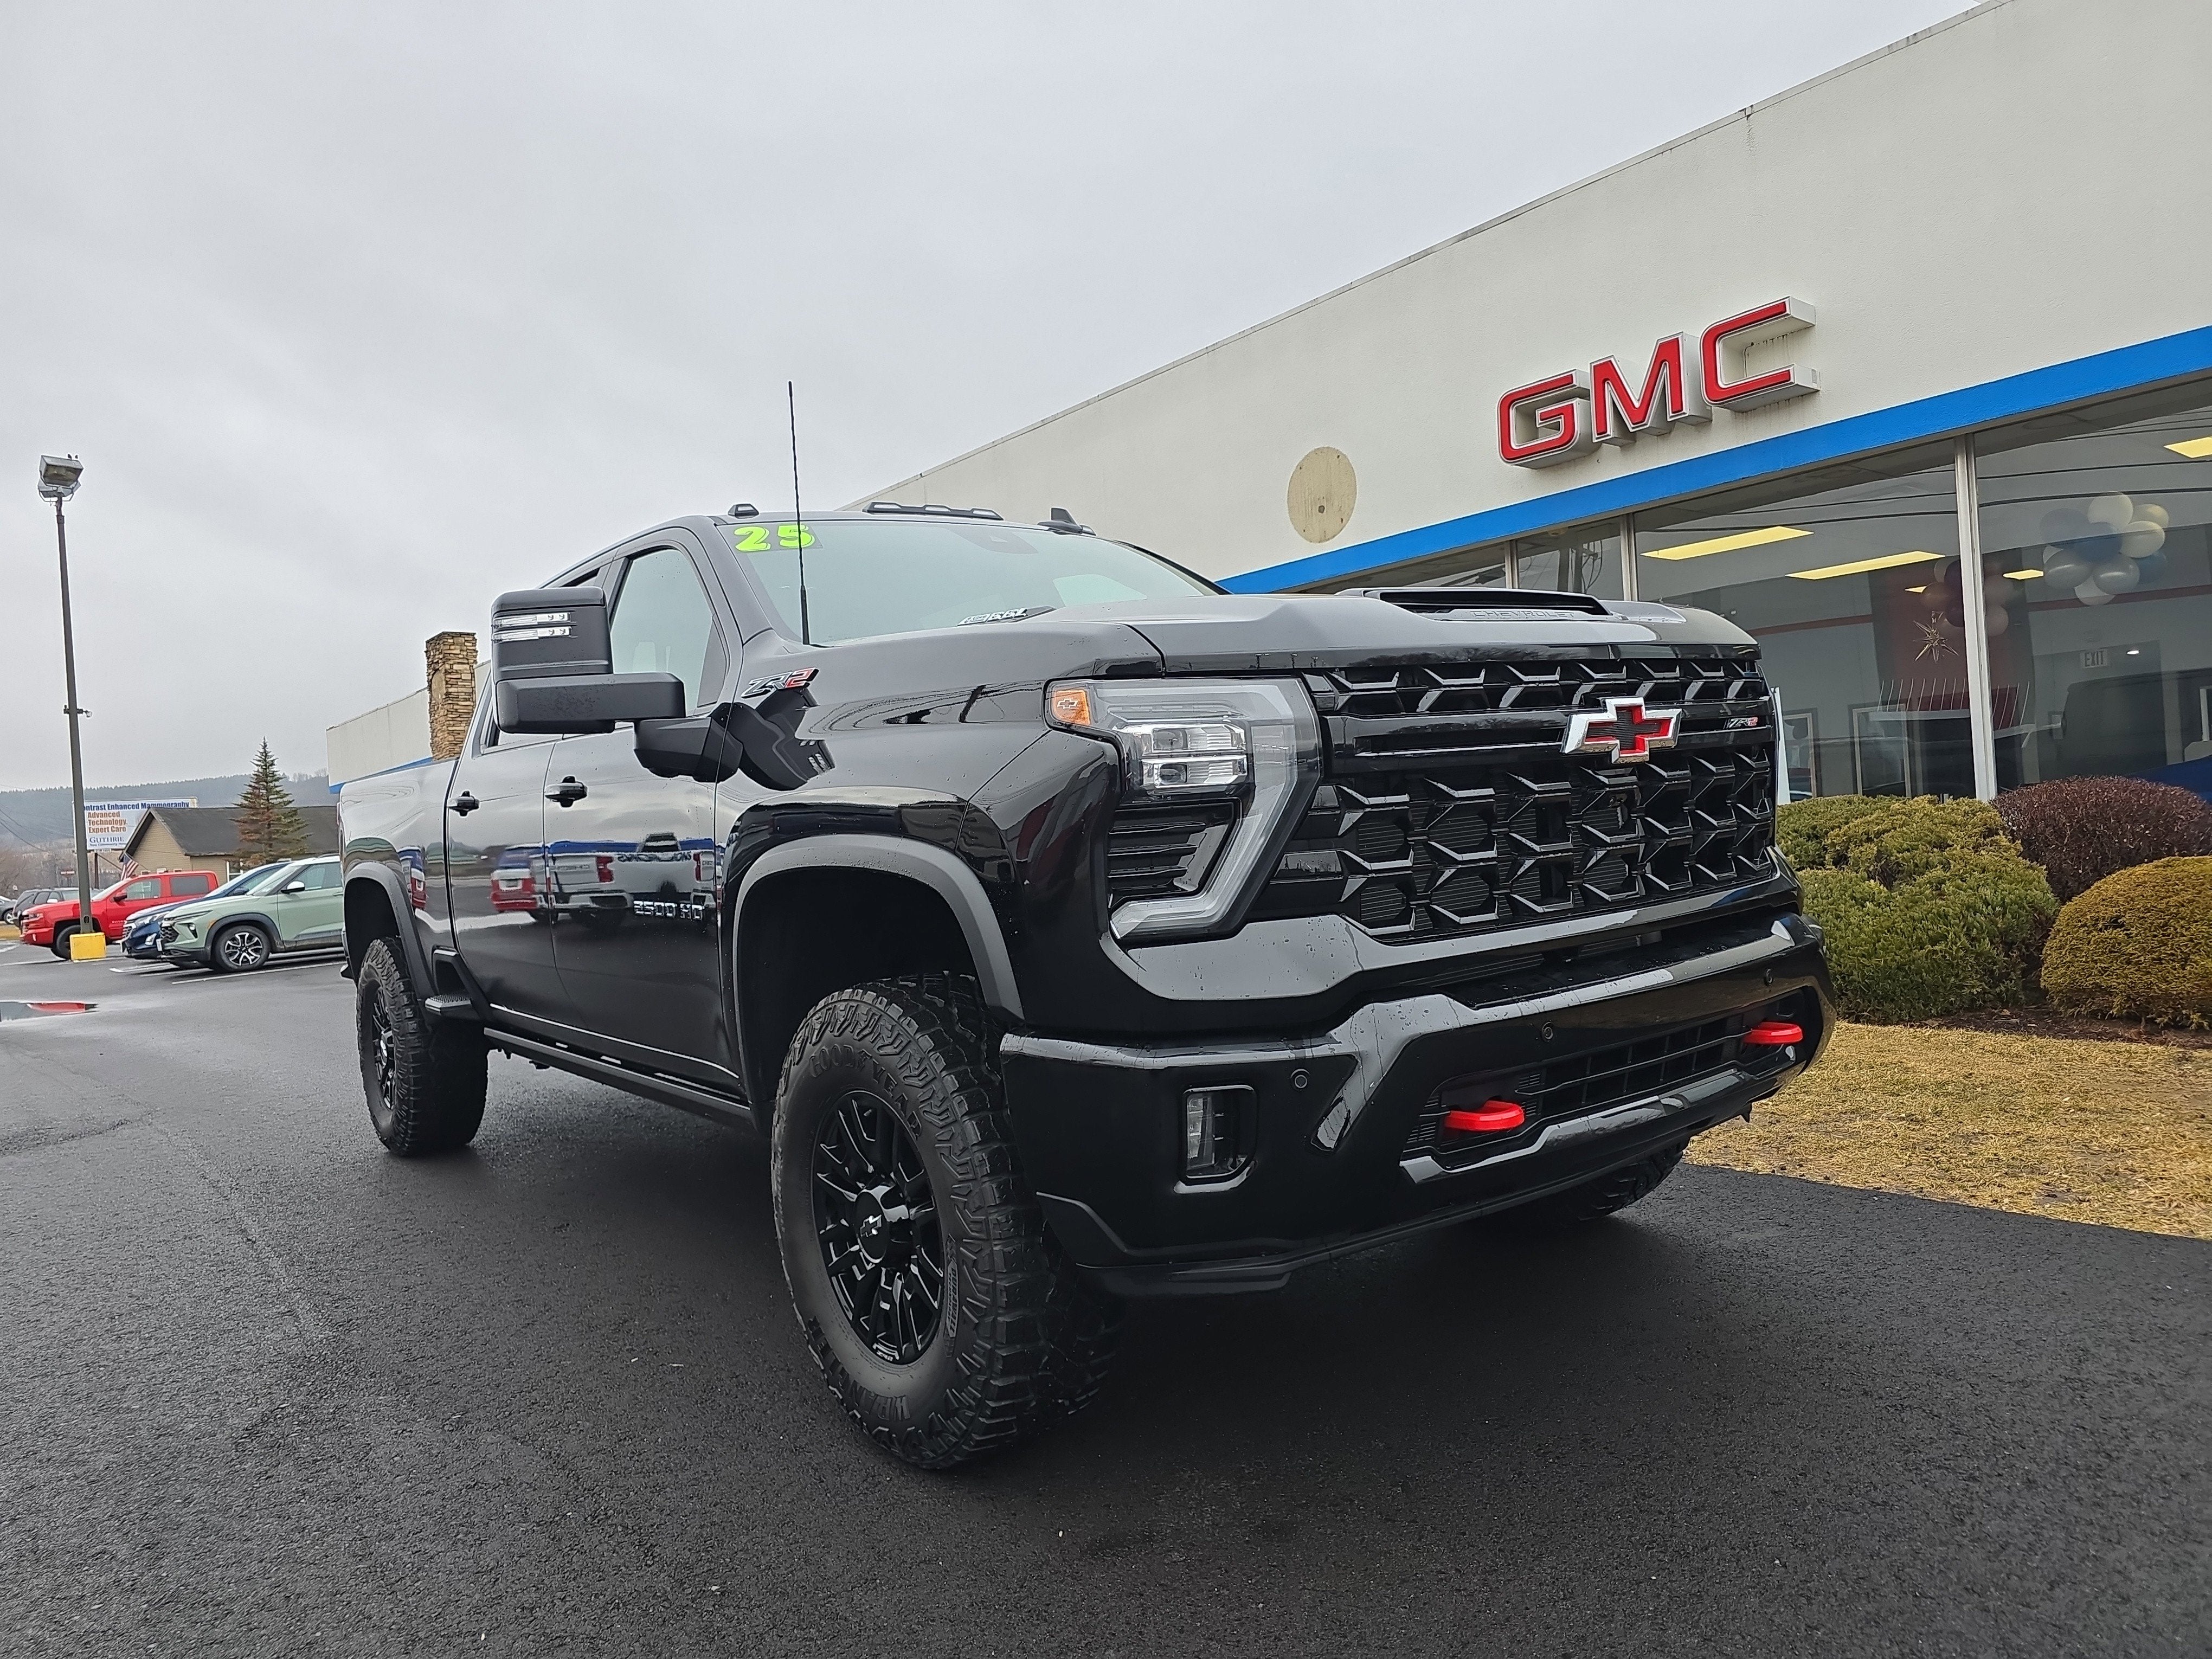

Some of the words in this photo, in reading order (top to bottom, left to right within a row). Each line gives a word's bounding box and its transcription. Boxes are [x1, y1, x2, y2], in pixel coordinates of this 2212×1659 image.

[1497, 295, 1803, 466] GMC
[734, 524, 815, 552] 25
[1470, 610, 1574, 619] CHEVROLET
[2084, 650, 2104, 667] EXIT
[741, 667, 819, 698] ZR2
[1728, 717, 1758, 728] ZR2
[107, 802, 140, 811] Enhanced
[633, 901, 678, 916] 2500
[680, 903, 705, 921] HD
[809, 1044, 922, 1141] GOODYEAR
[808, 1315, 911, 1420] WRANGLER
